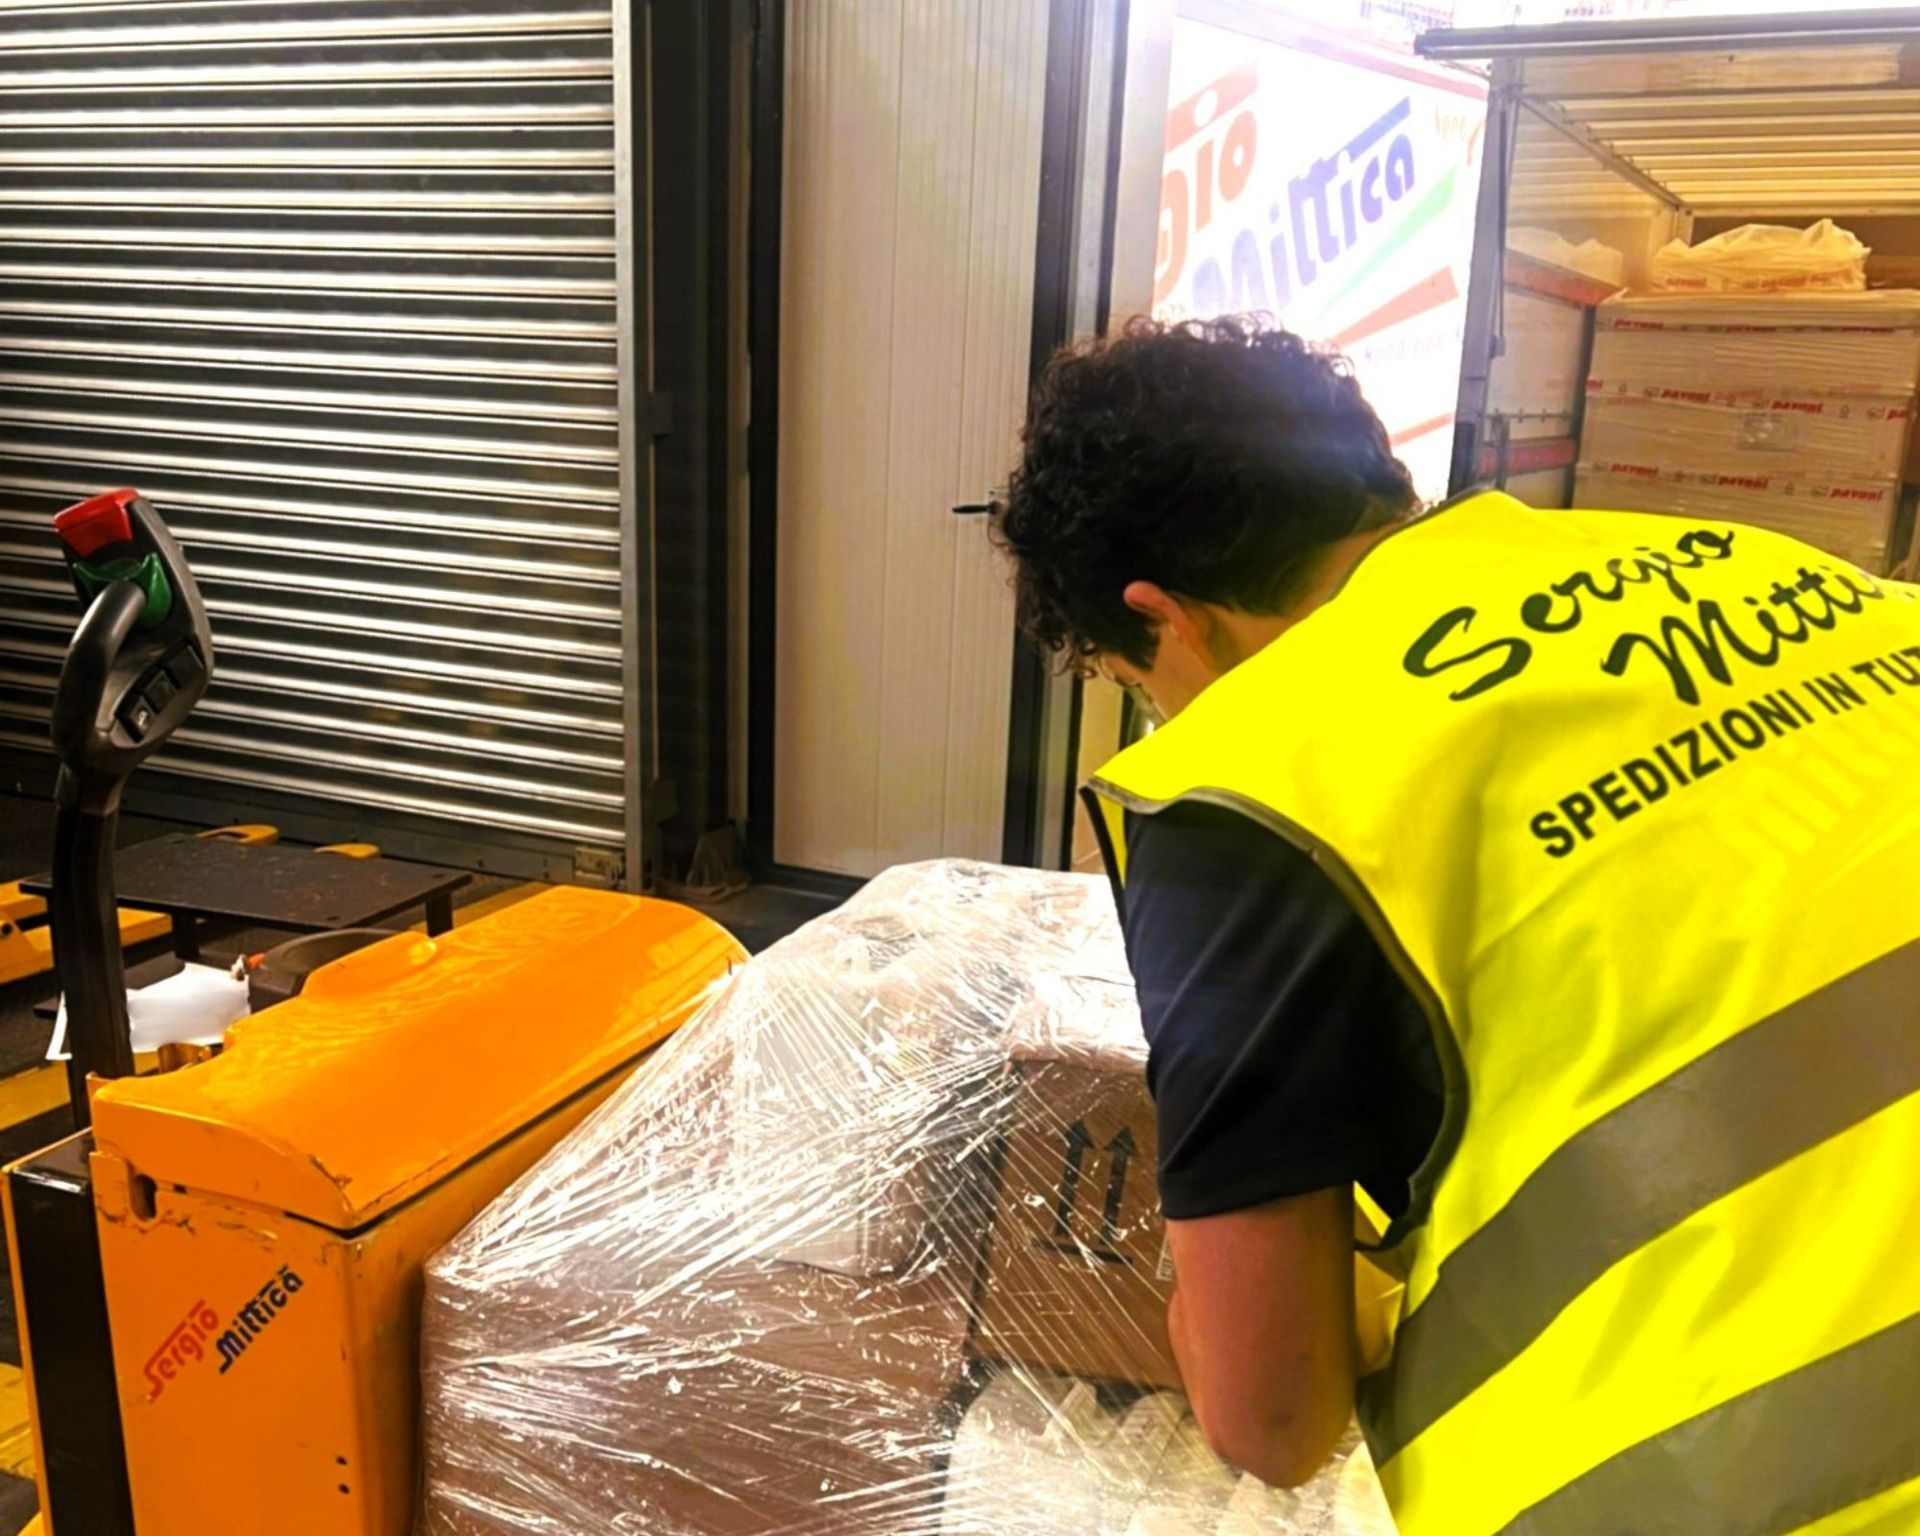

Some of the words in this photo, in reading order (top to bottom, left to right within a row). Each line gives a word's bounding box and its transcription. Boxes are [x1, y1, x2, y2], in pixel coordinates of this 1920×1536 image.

[1661, 387, 1711, 404] pavoni
[1771, 399, 1824, 415] pavoni
[1610, 460, 1660, 477] pavoni
[1718, 474, 1769, 490] pavoni
[1830, 486, 1884, 502] pavoni
[1403, 530, 1735, 701] Sergio
[1530, 689, 1815, 858] SPEDIZIONI
[1801, 672, 1868, 715] IN
[143, 1299, 219, 1405] Sergio
